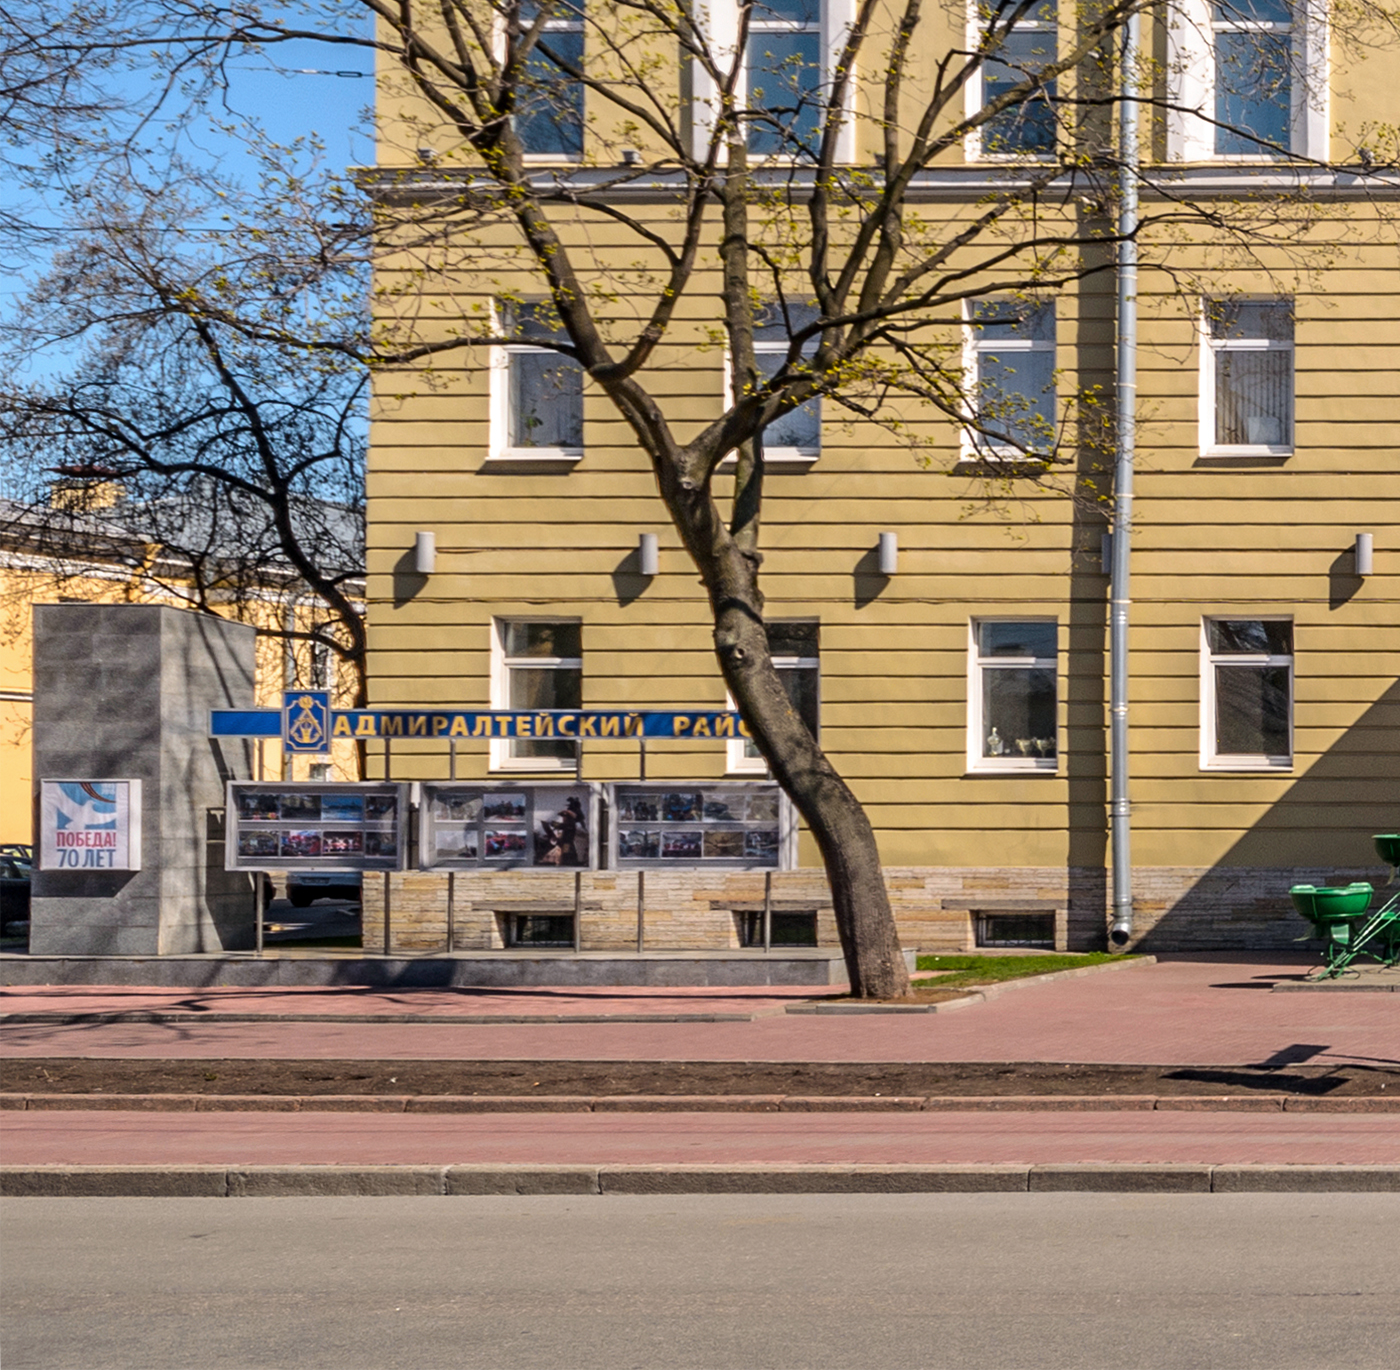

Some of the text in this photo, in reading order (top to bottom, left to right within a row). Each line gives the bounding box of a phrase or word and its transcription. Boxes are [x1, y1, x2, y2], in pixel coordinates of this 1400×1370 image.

[332, 711, 644, 738] АДМИРАЛТЕЙСКИЙ
[56, 831, 117, 848] ПОБЕДА!
[56, 848, 117, 868] 70 ЛЕТ
